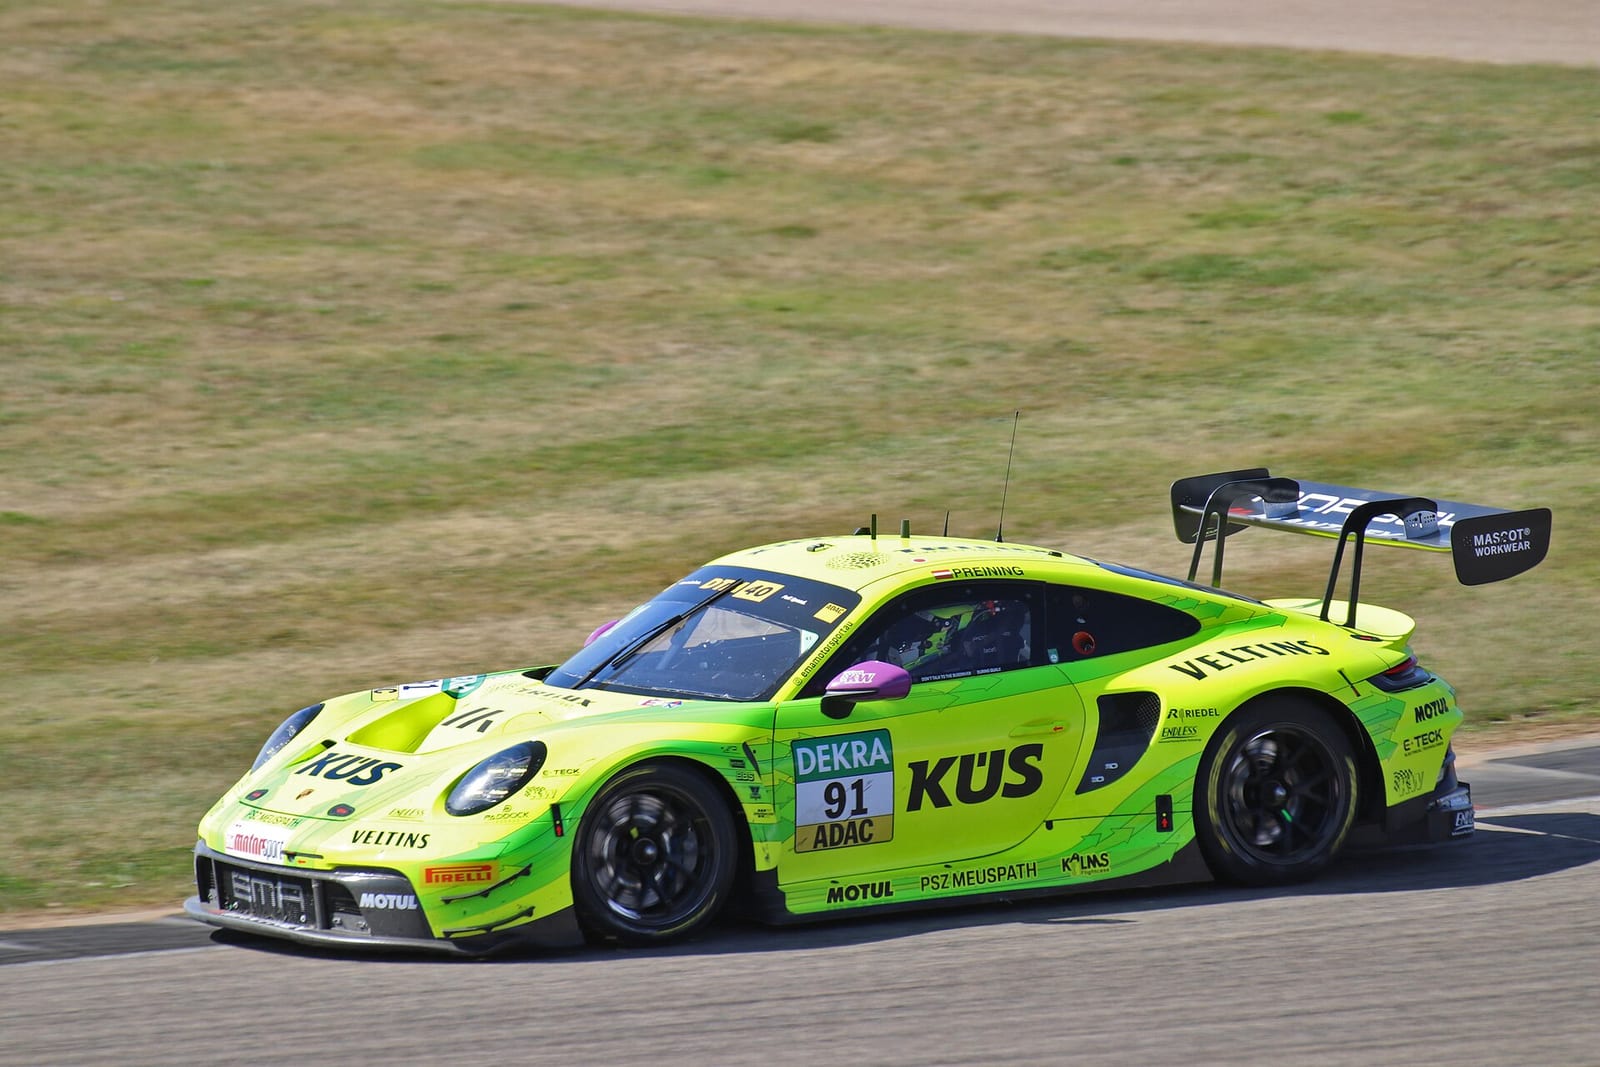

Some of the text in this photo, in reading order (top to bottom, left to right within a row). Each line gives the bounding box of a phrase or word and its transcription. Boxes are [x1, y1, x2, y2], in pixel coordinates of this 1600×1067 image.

[1475, 541, 1531, 557] WORKWEAR
[952, 567, 1024, 578] PREINING
[745, 584, 773, 597] 40
[825, 604, 845, 615] ADAC
[1168, 639, 1330, 681] VELTINS
[1185, 707, 1220, 718] RIEDEL
[1414, 697, 1450, 724] MOTUL
[1162, 725, 1199, 738] ENDLESS
[796, 737, 890, 776] DEKRA
[296, 752, 403, 786] KÜS
[906, 743, 1044, 813] KÜS
[824, 778, 868, 820] 91
[351, 830, 431, 849] VELTINS
[813, 818, 874, 850] ADAC
[1061, 852, 1110, 873] KALMS
[425, 865, 493, 884] PIRELLI
[920, 862, 1037, 892] PSZ MEUSPATH
[359, 893, 418, 910] MOTUL
[826, 880, 894, 904] MOTUL
